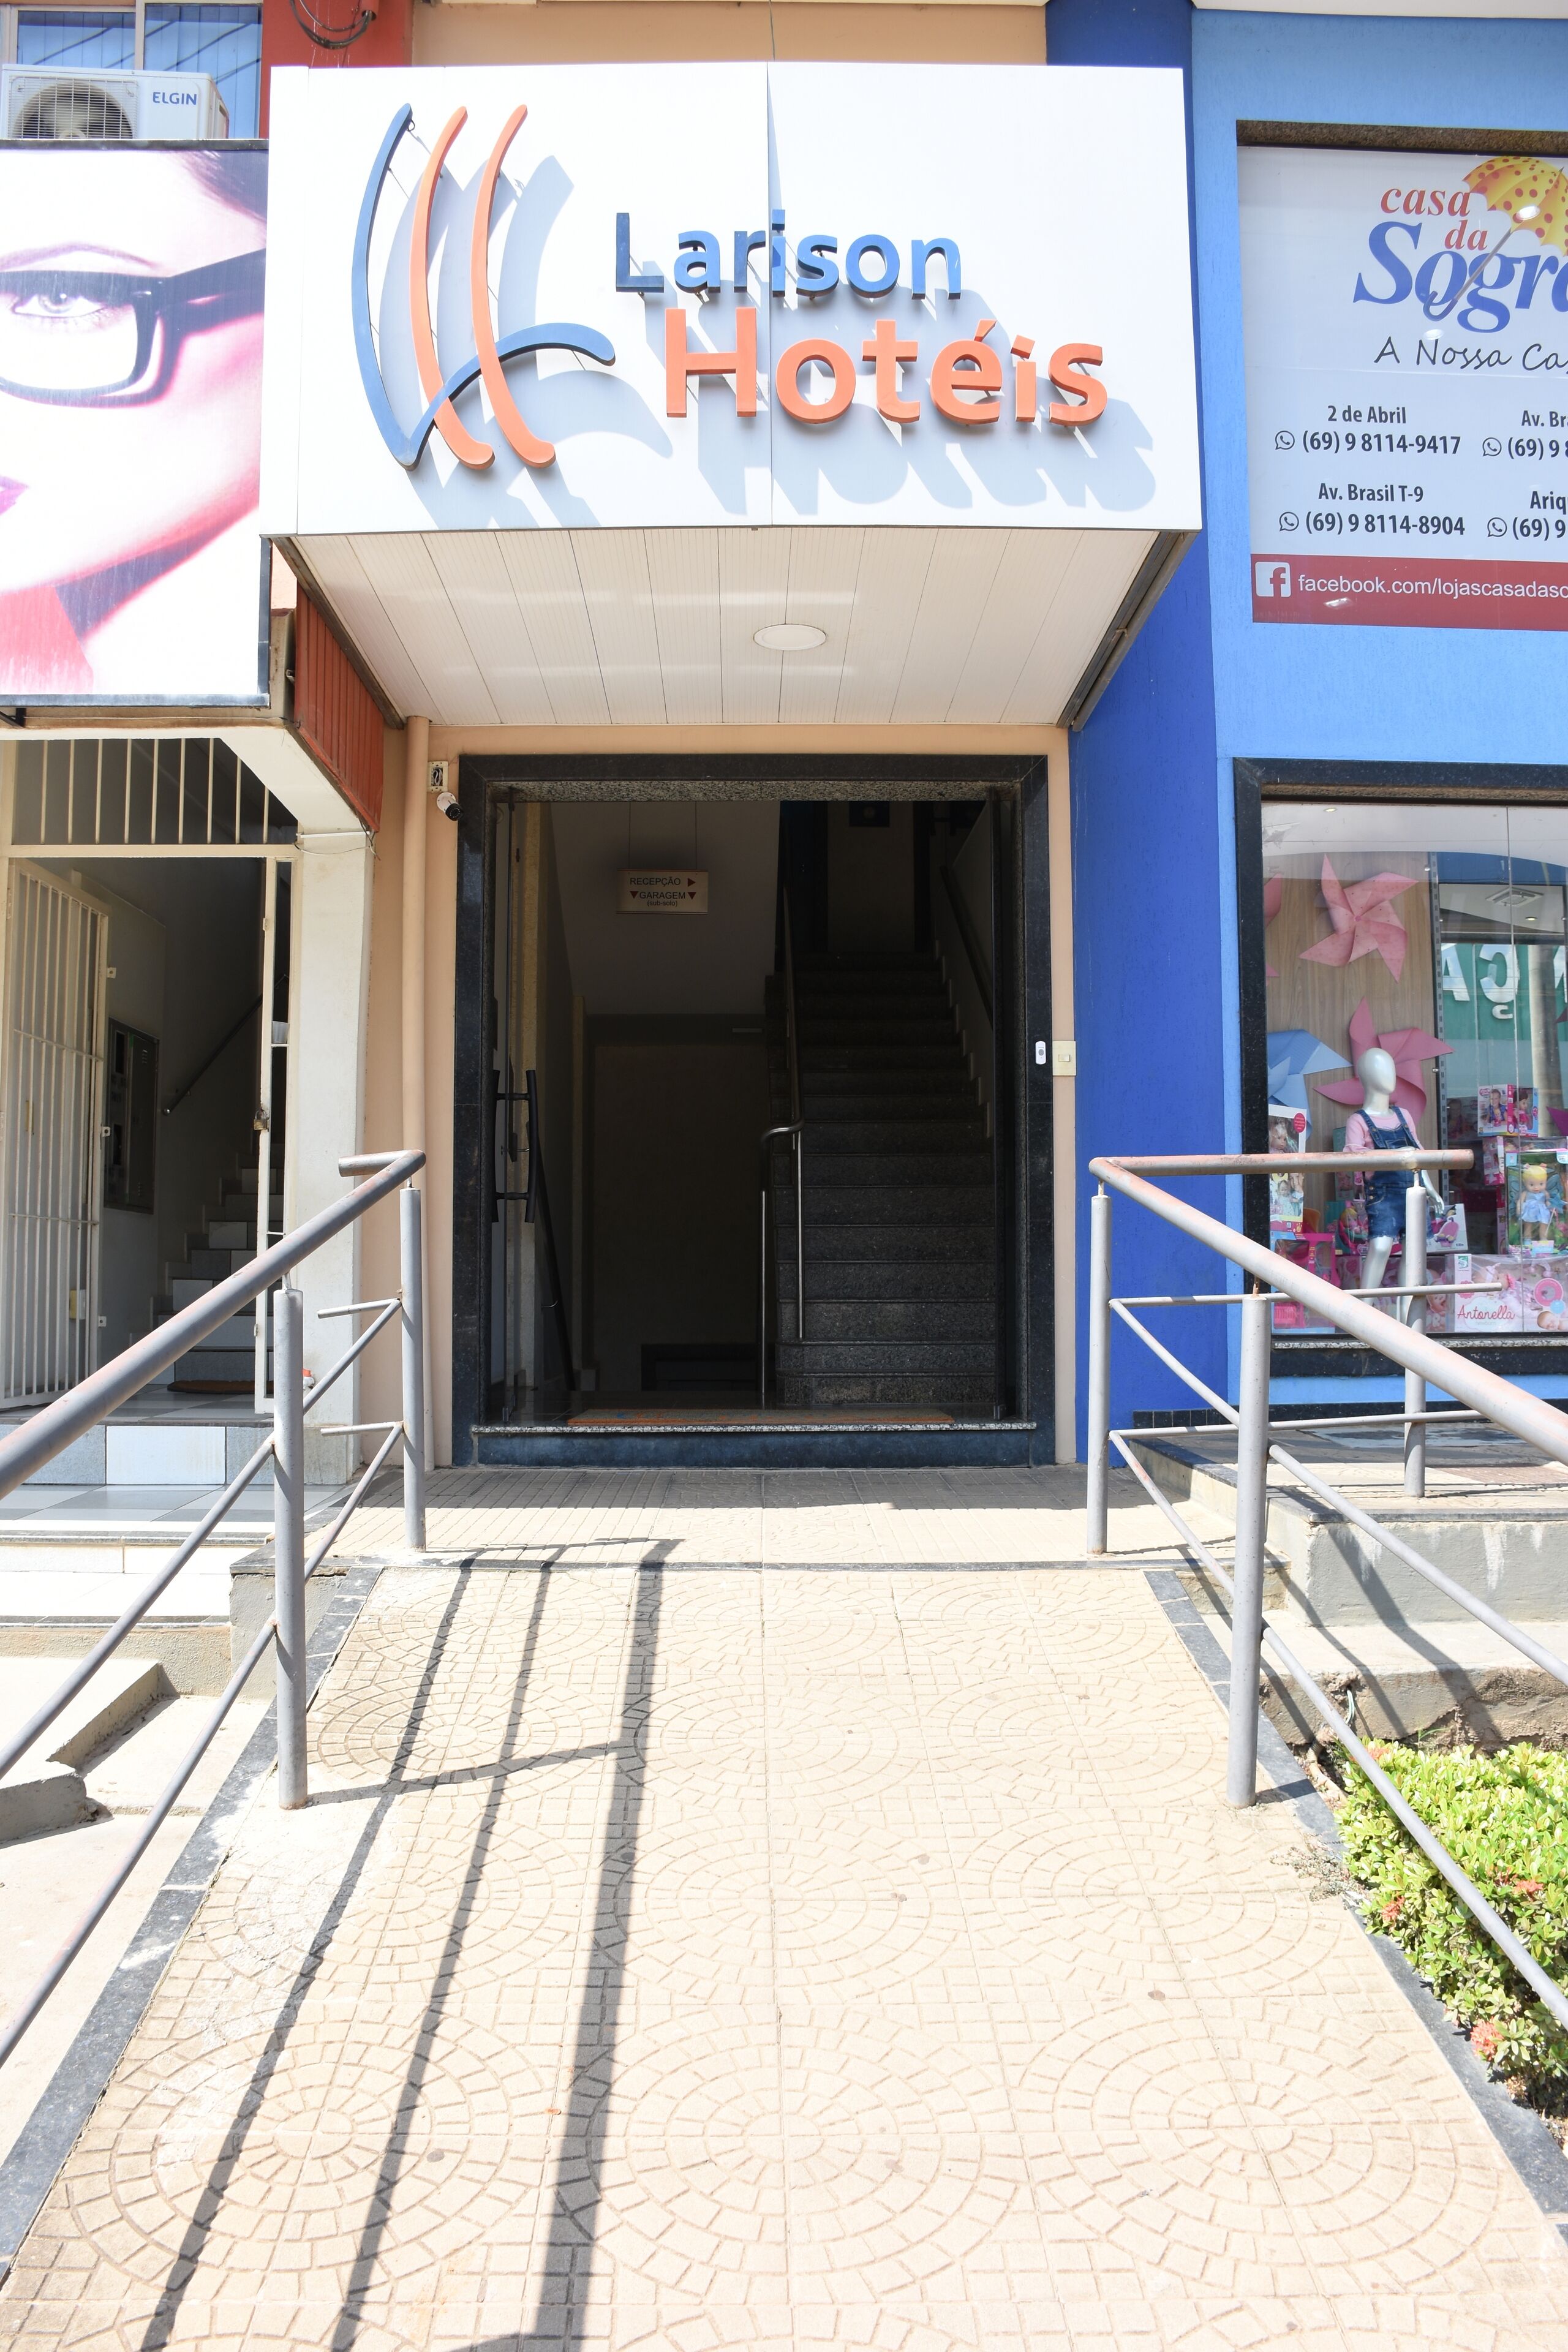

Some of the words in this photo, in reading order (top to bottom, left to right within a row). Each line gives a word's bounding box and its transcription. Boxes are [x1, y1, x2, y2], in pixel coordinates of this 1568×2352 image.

[153, 92, 197, 105] ELGIN
[1380, 188, 1471, 217] casa
[1444, 219, 1488, 251] da
[616, 209, 962, 300] Larison
[665, 307, 1108, 427] Hotéis
[1374, 336, 1400, 364] A
[1416, 338, 1512, 370] Nossa
[1522, 343, 1568, 375] Ca
[1327, 405, 1337, 421] 2
[1342, 405, 1363, 423] de
[1366, 406, 1406, 424] Abril
[1521, 410, 1545, 427] Av.
[1549, 411, 1568, 428] Br
[1303, 431, 1340, 454] (69)
[1345, 432, 1356, 451] 9
[1361, 433, 1461, 454] 8114-9417
[1507, 437, 1544, 460] (69)
[1548, 439, 1559, 458] 9
[1318, 483, 1343, 500] Av.
[1348, 484, 1395, 502] Brasil
[1398, 485, 1423, 502] T-9
[1529, 491, 1568, 515] Ariq
[1306, 511, 1343, 535] (69)
[1348, 514, 1359, 532] 9
[1364, 514, 1465, 535] 8114-8904
[1512, 516, 1550, 541] (69)
[1555, 519, 1566, 538] 9
[630, 876, 681, 887] RECEPÇÃO
[1457, 1305, 1515, 1319] Antonella
